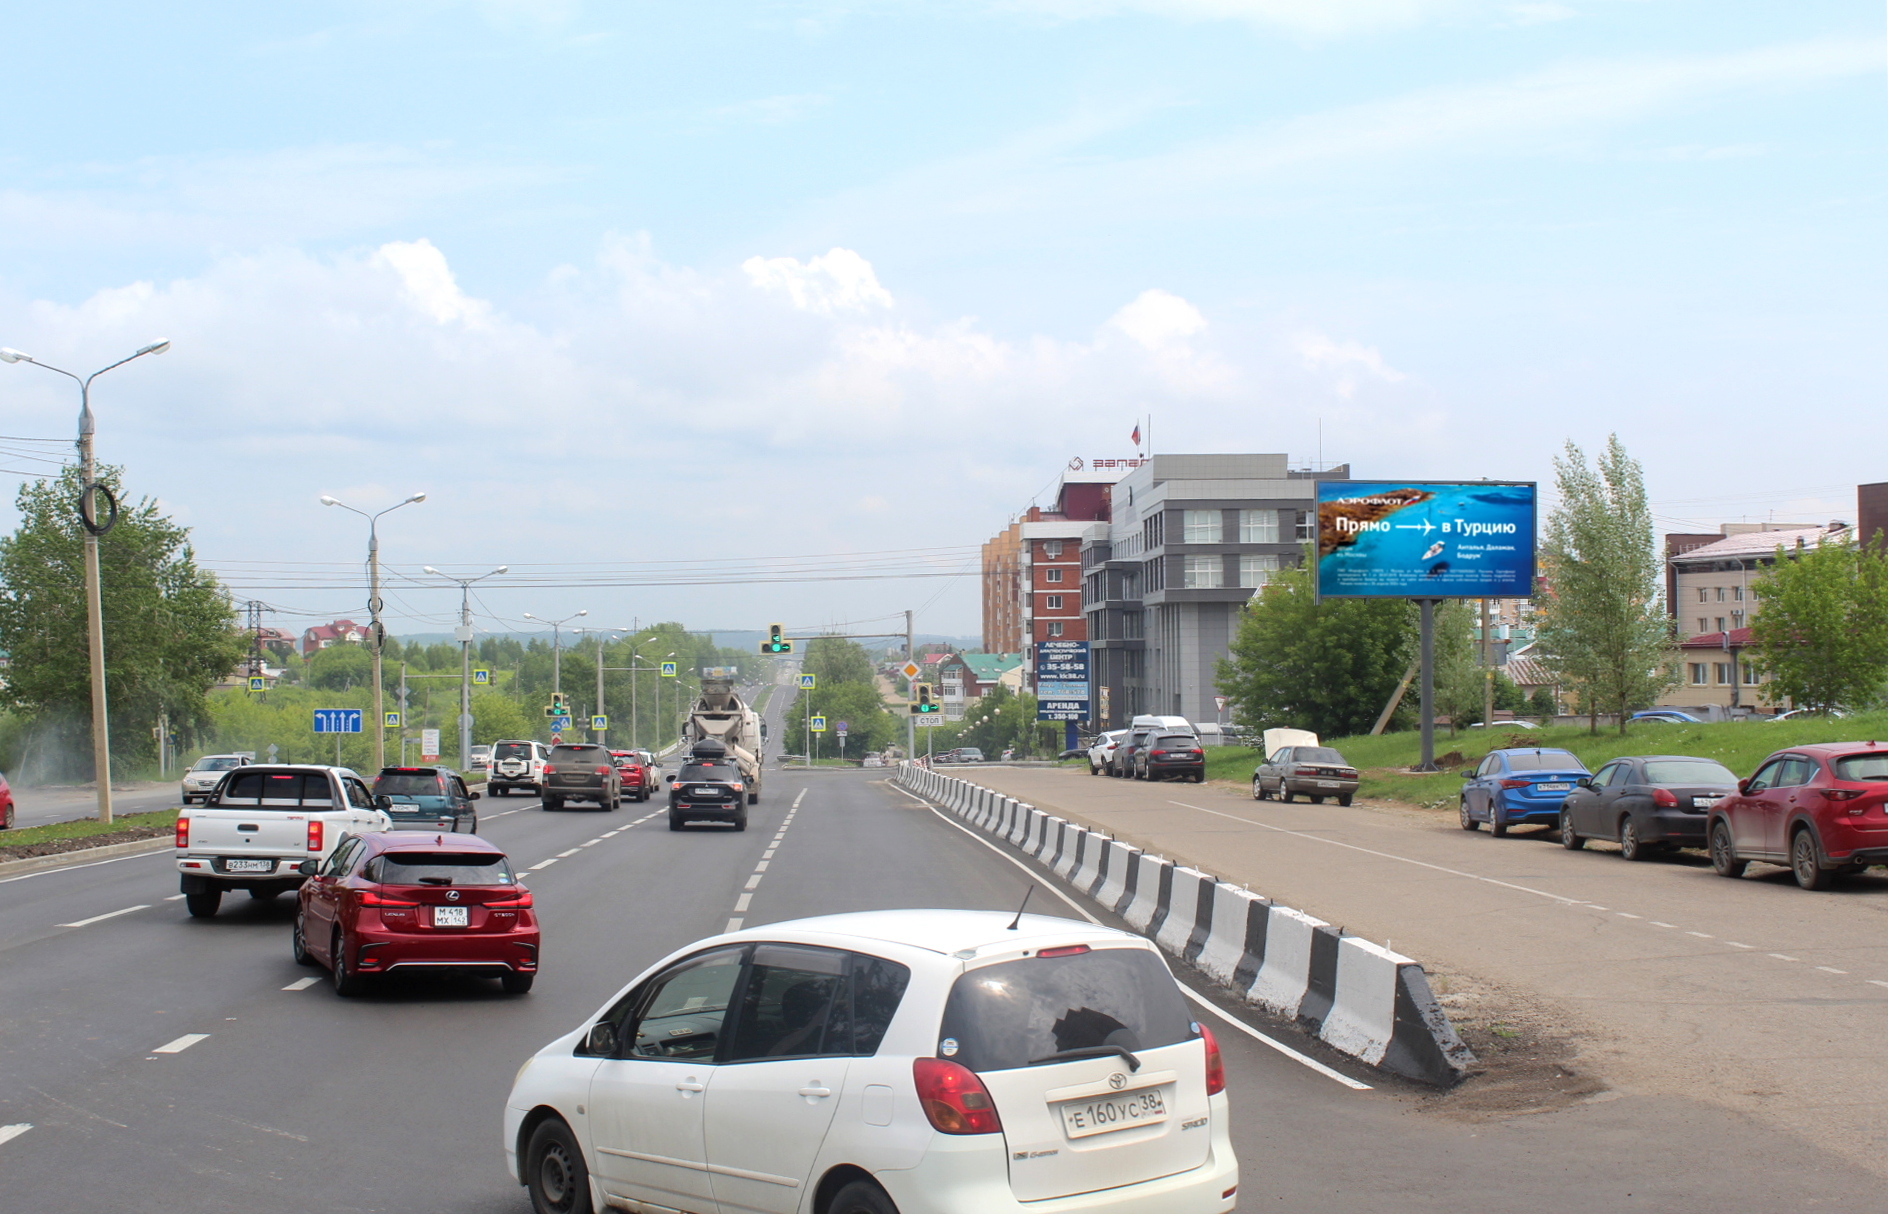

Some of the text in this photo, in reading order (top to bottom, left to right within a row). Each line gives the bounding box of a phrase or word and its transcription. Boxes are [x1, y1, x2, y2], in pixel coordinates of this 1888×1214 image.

[1337, 497, 1403, 505] АЭРОФЛОТ
[1336, 517, 1516, 537] Прямо в Турцию
